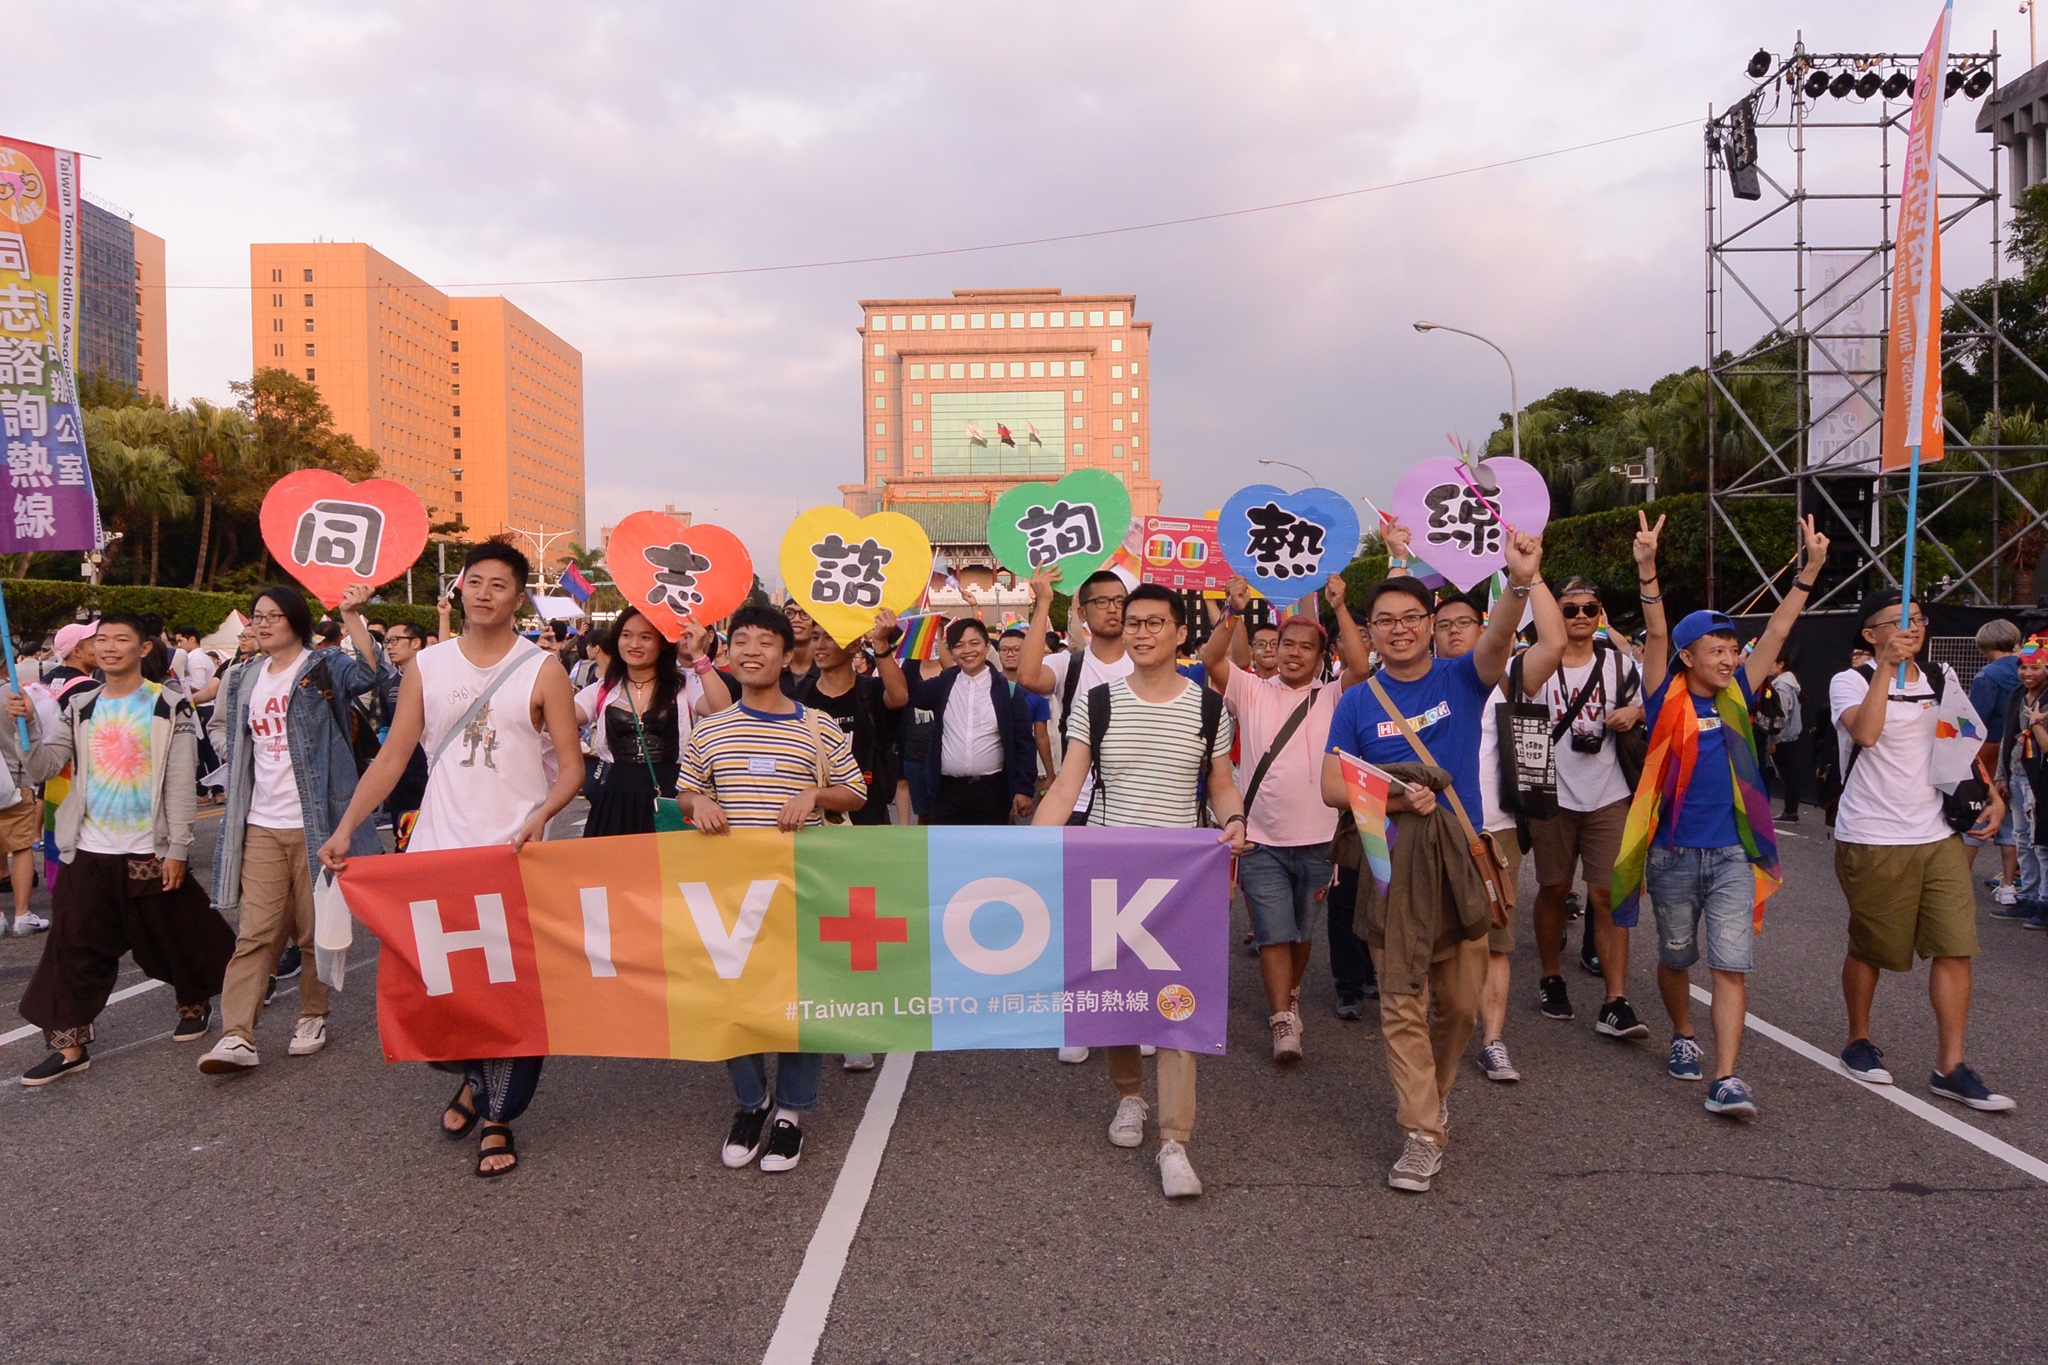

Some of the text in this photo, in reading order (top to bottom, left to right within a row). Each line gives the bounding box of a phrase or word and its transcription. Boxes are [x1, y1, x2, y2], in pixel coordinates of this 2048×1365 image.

[60, 156, 72, 207] Taiwan
[64, 212, 76, 260] Tonzhi
[62, 265, 74, 320] Hotline
[0, 231, 57, 540] 同志諮詢熱線
[293, 500, 384, 577] 同
[1016, 500, 1103, 569] 詢
[1244, 501, 1326, 580] 熱
[1423, 483, 1502, 557] 線
[643, 543, 711, 616] 志
[810, 534, 893, 608] 諮
[252, 717, 287, 737] HI
[785, 990, 1149, 1020] #Taiwan LGBTQ #同志諮詢熱線
